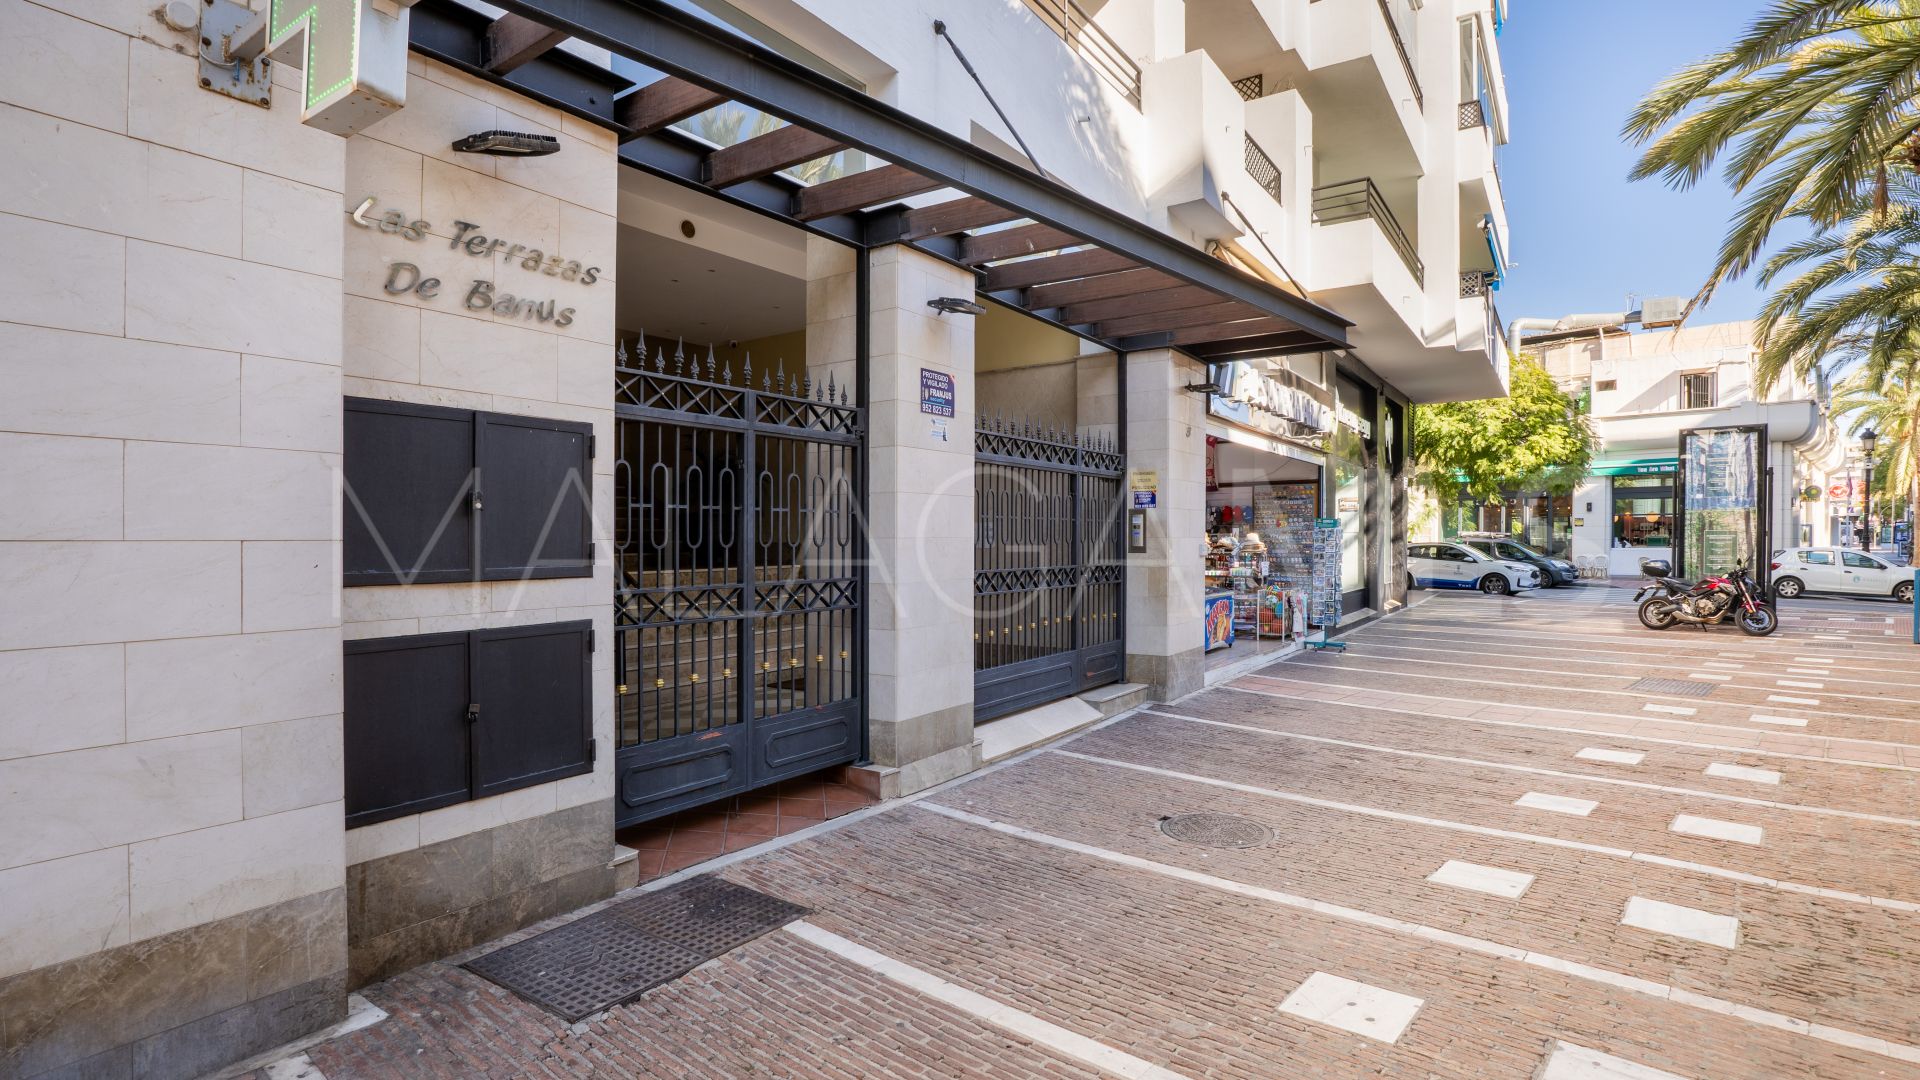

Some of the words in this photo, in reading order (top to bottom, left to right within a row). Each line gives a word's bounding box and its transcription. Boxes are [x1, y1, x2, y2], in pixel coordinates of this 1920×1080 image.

[352, 196, 432, 241] Las
[449, 220, 602, 286] Terrazas
[384, 261, 442, 300] De
[464, 279, 577, 328] Banus
[922, 371, 948, 382] PROTEGIDO
[927, 379, 949, 390] VIGILADO
[930, 388, 952, 400] FRANJUS
[922, 403, 932, 413] 952
[932, 405, 942, 415] 823
[942, 407, 952, 416] 537
